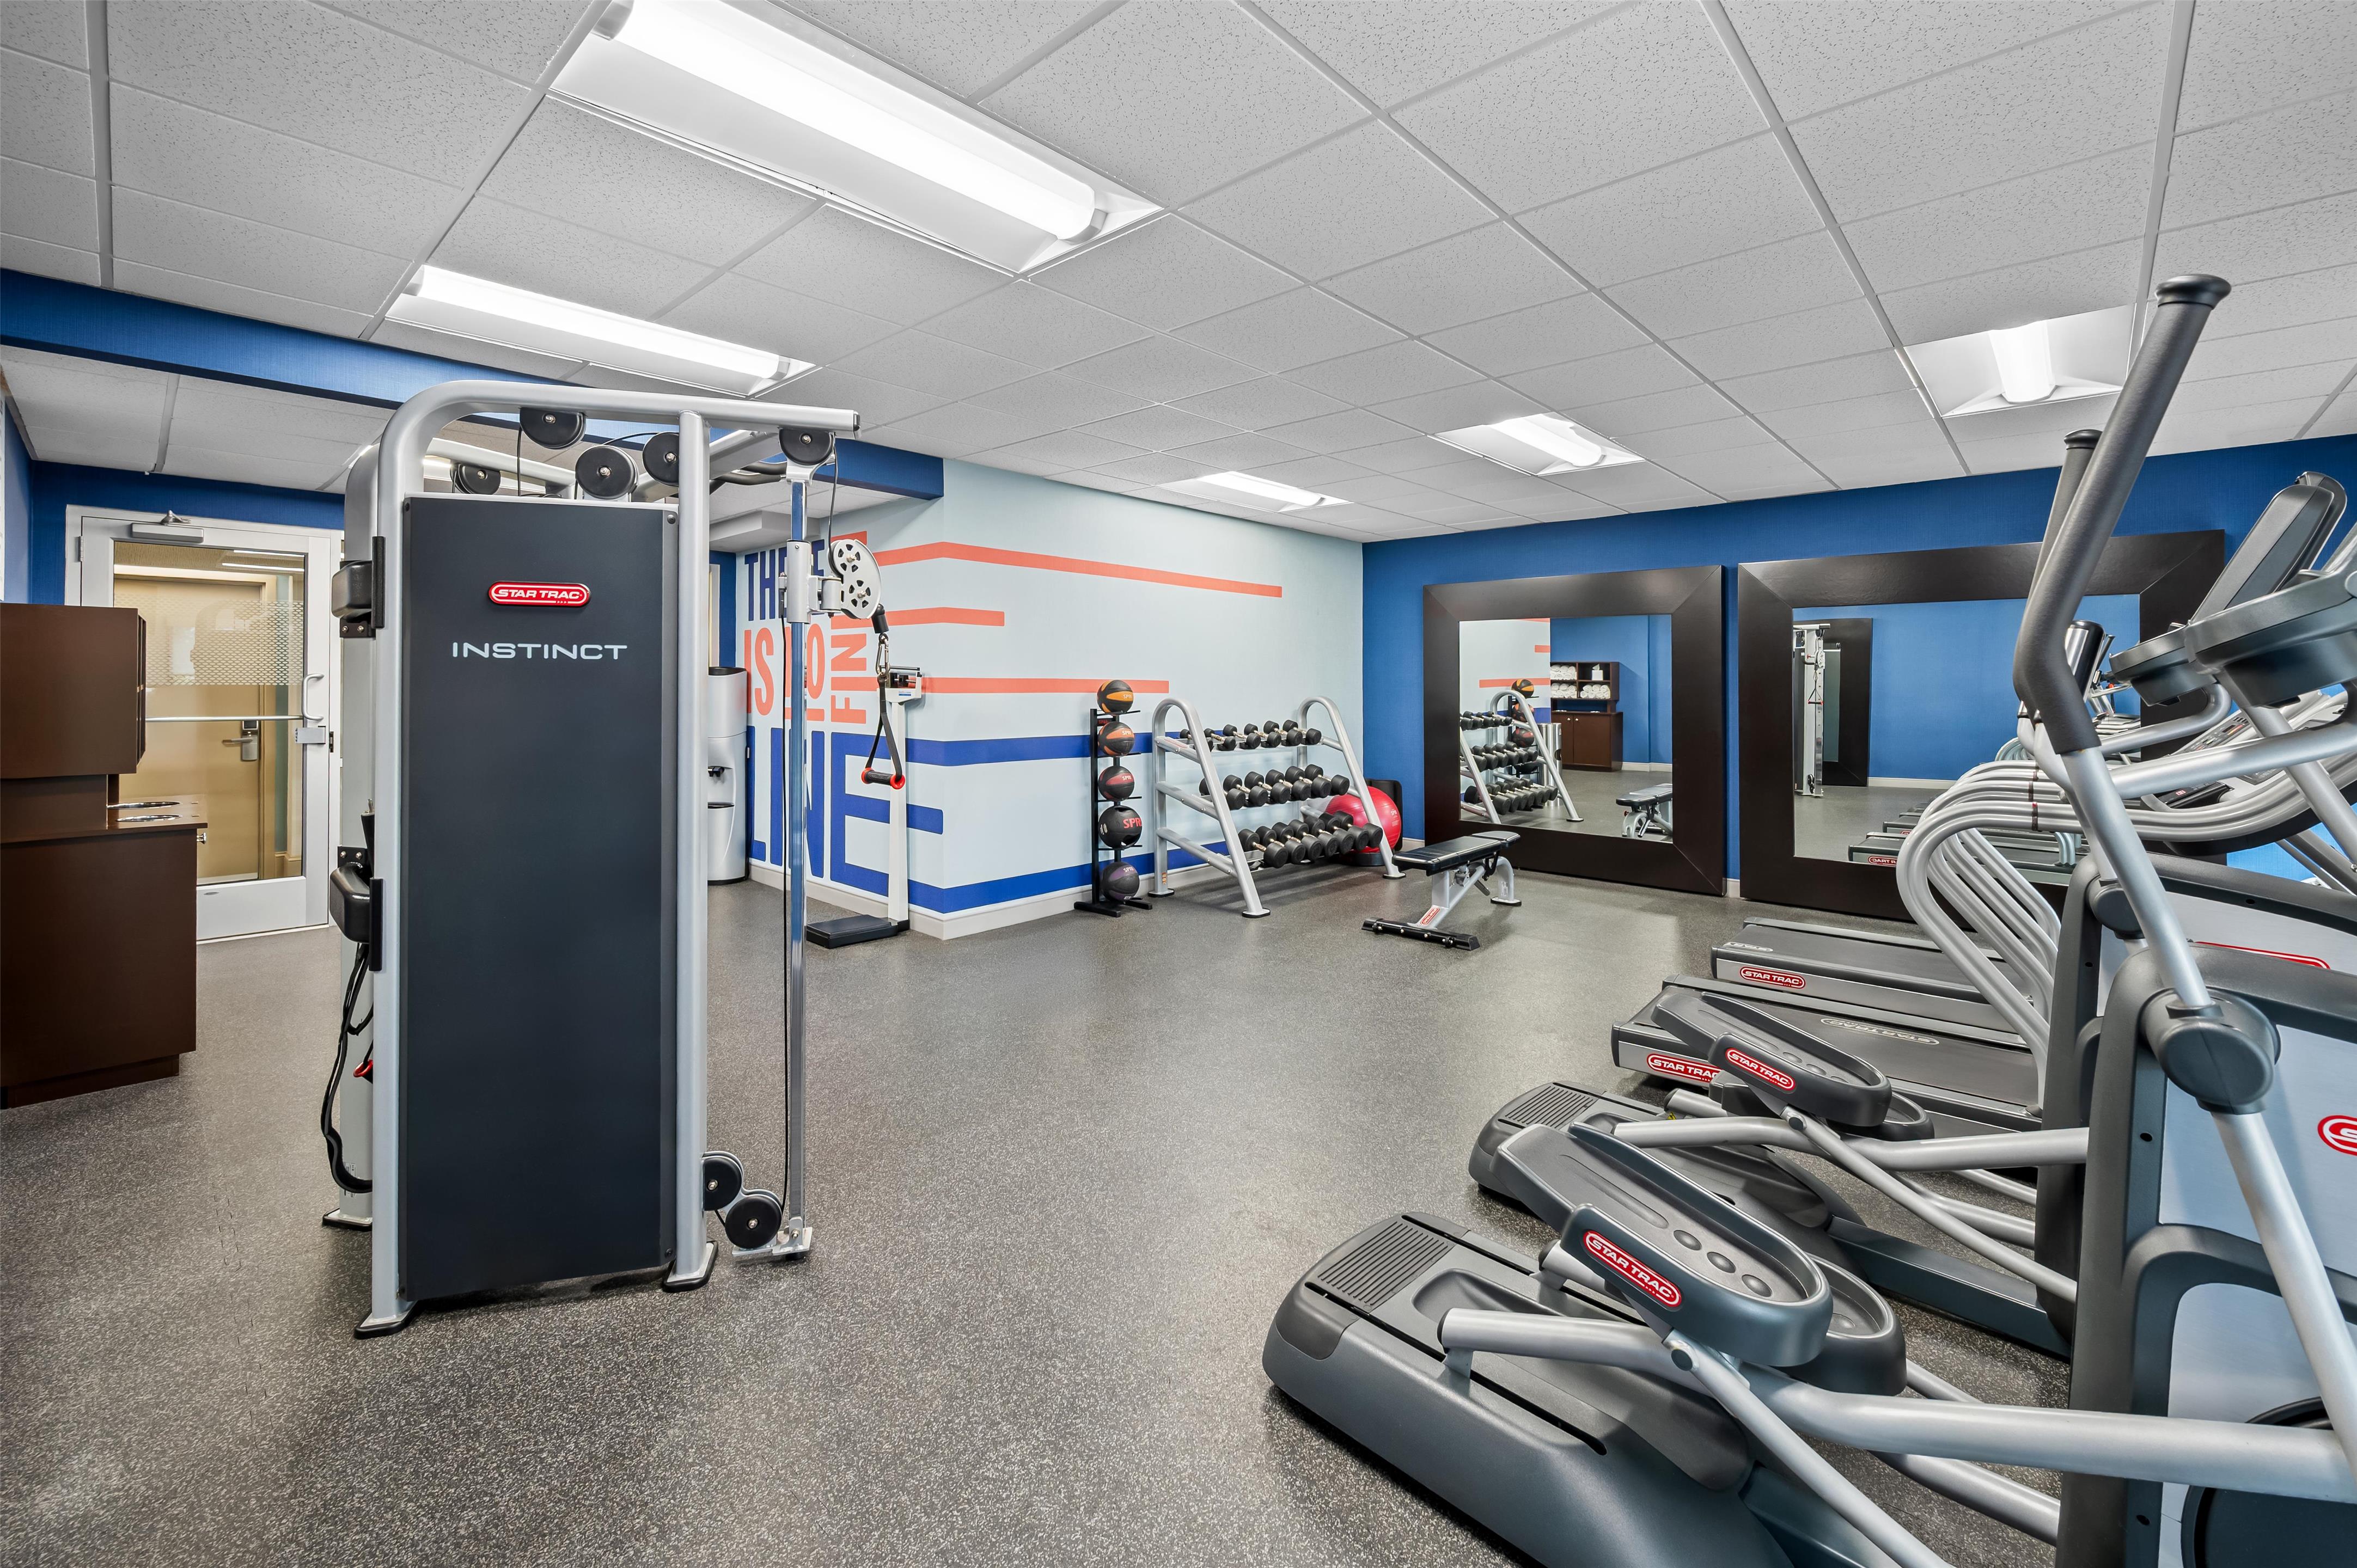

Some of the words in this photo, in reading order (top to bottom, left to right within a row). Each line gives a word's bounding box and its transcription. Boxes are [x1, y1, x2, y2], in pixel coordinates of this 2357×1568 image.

[497, 589, 537, 598] STAR
[539, 590, 579, 599] TRAC
[453, 642, 627, 660] INSTINCT
[744, 627, 774, 716] IS
[1744, 971, 1770, 980] STAR
[1772, 976, 1800, 984] TRAC
[1653, 1059, 1685, 1071] STAR
[1732, 1052, 1758, 1069] STAR
[1759, 1066, 1789, 1085] TRAC
[1592, 1239, 1629, 1269] STAR
[1631, 1265, 1672, 1297] TRAC
